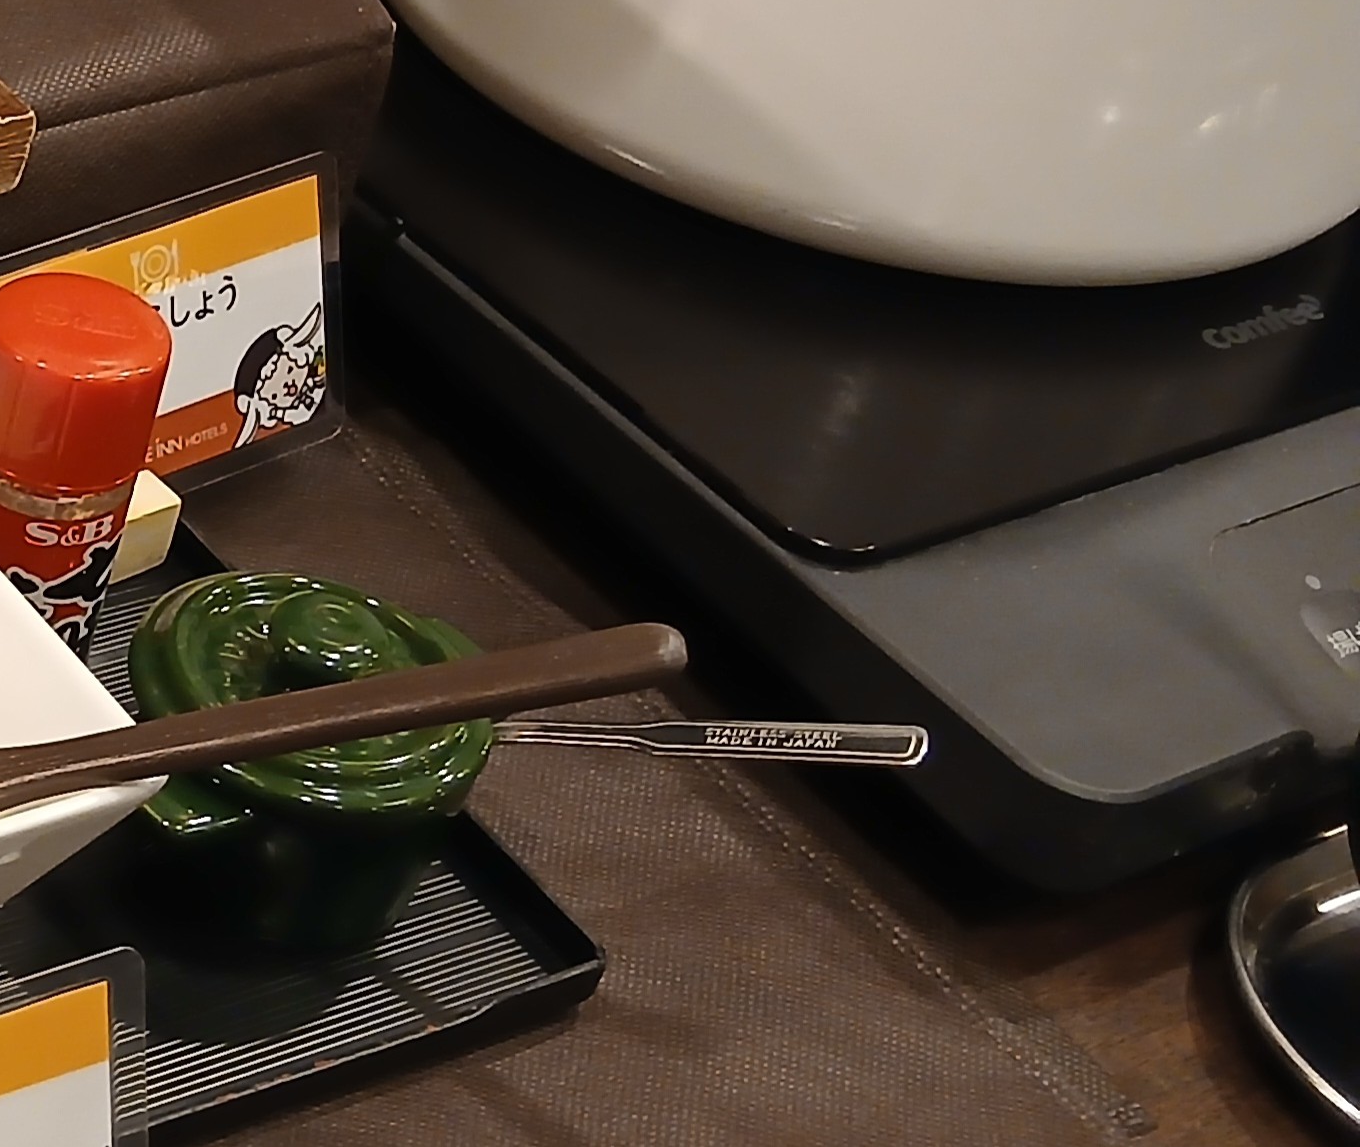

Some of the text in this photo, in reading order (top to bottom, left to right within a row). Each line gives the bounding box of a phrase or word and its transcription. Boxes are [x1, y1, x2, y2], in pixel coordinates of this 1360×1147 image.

[152, 275, 237, 327] しょう
[184, 421, 229, 448] HOTELS
[24, 514, 115, 547] S&B
[705, 728, 843, 740] STAINLESS STEEL
[706, 736, 838, 749] MADE IN JAPAN
